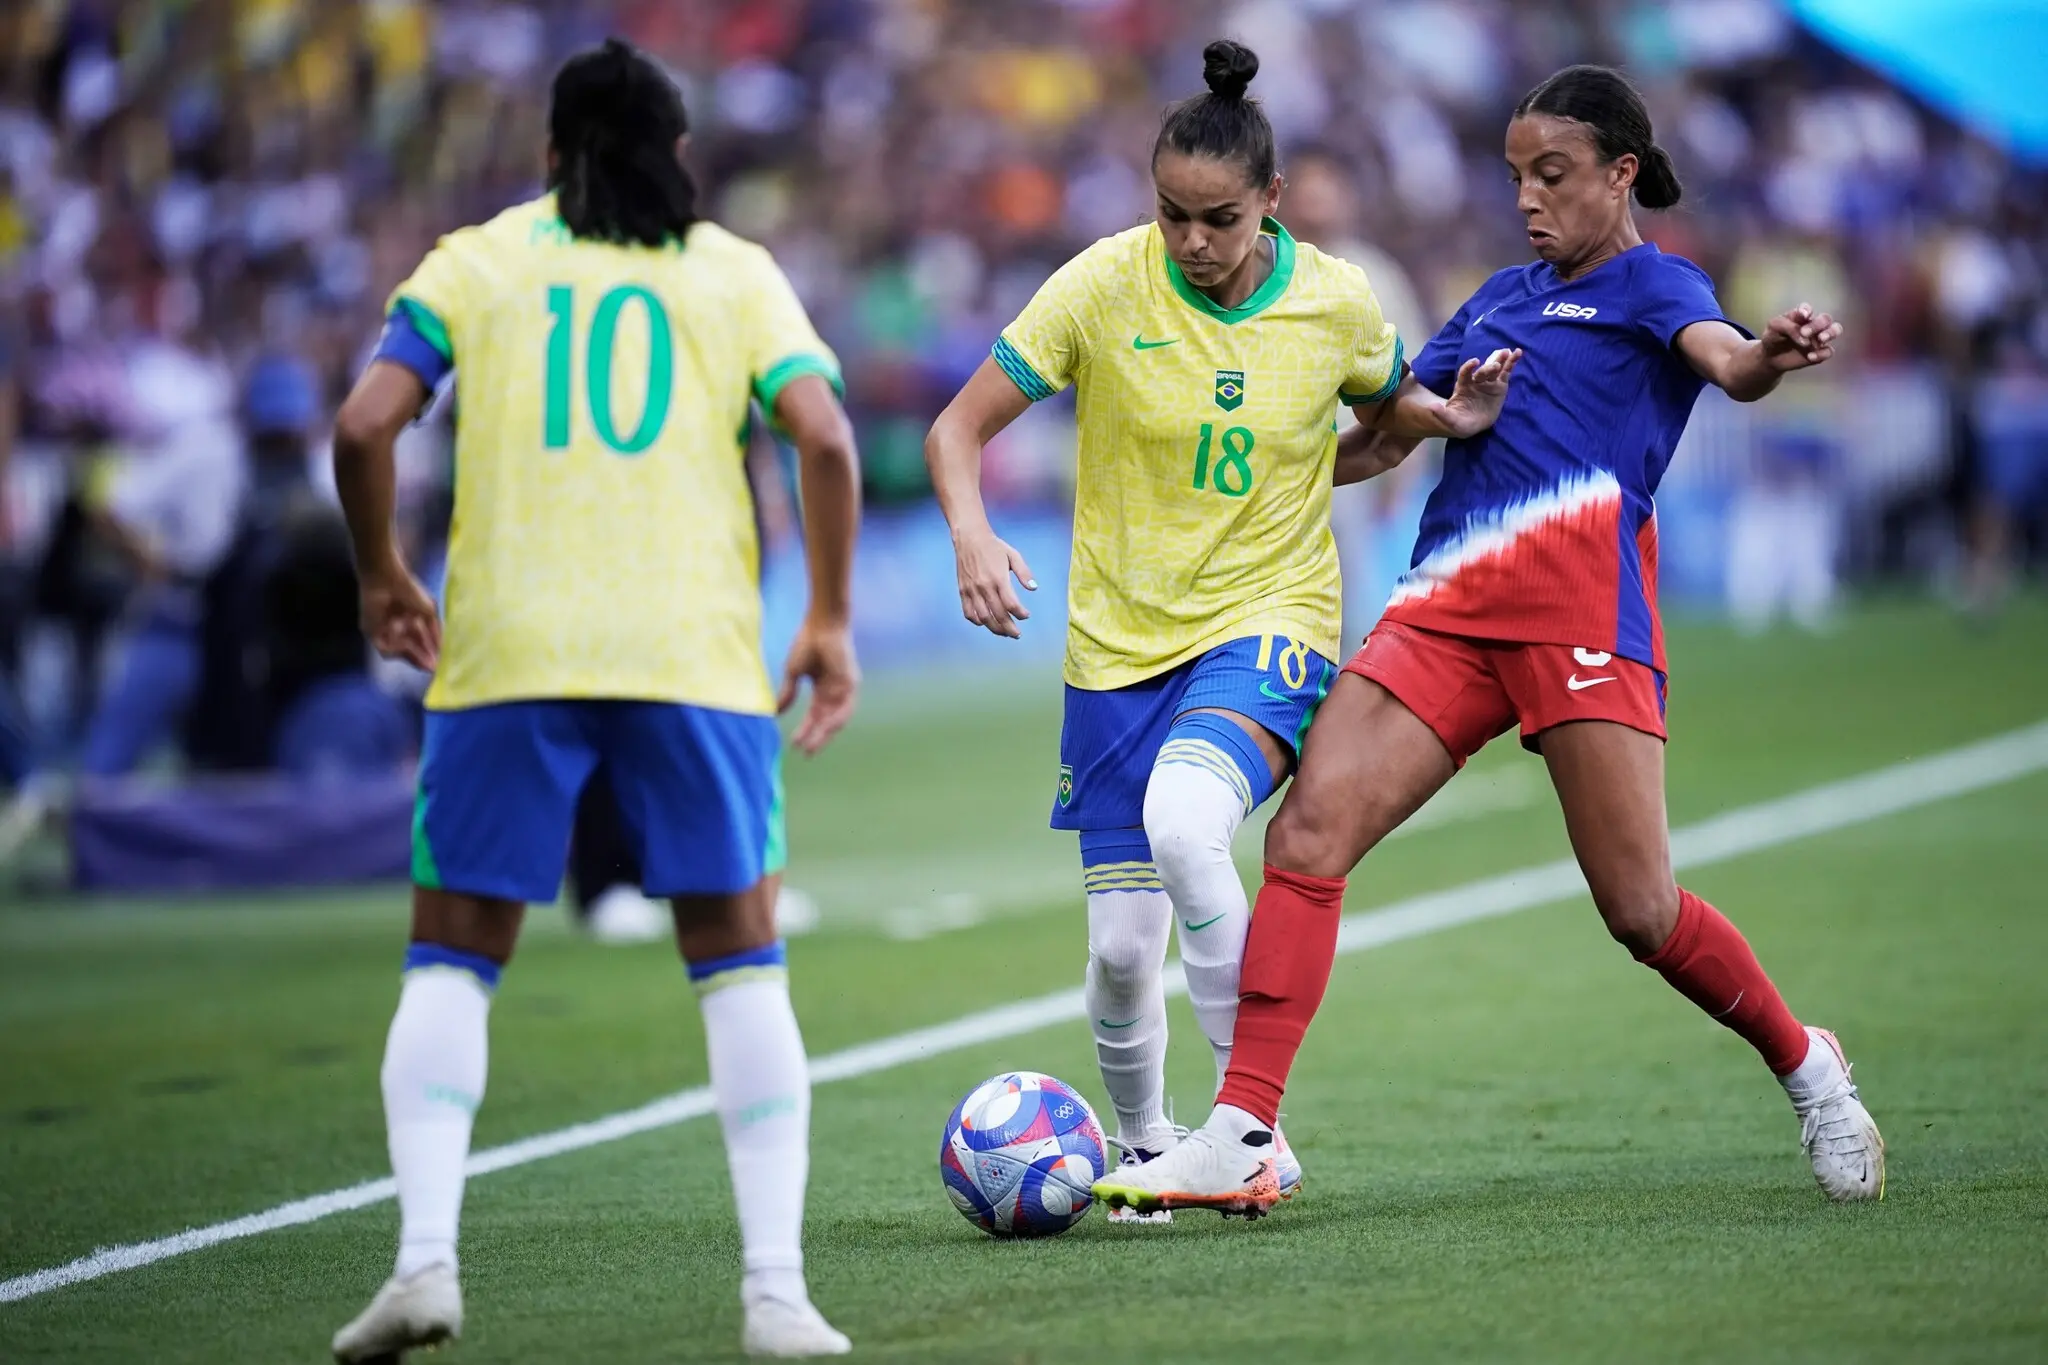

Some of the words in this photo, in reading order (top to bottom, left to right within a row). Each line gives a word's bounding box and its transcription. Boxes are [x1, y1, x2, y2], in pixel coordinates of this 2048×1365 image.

[1542, 302, 1598, 320] USA
[545, 283, 674, 454] 10
[1216, 371, 1244, 381] BRASIL
[1192, 423, 1255, 498] 18
